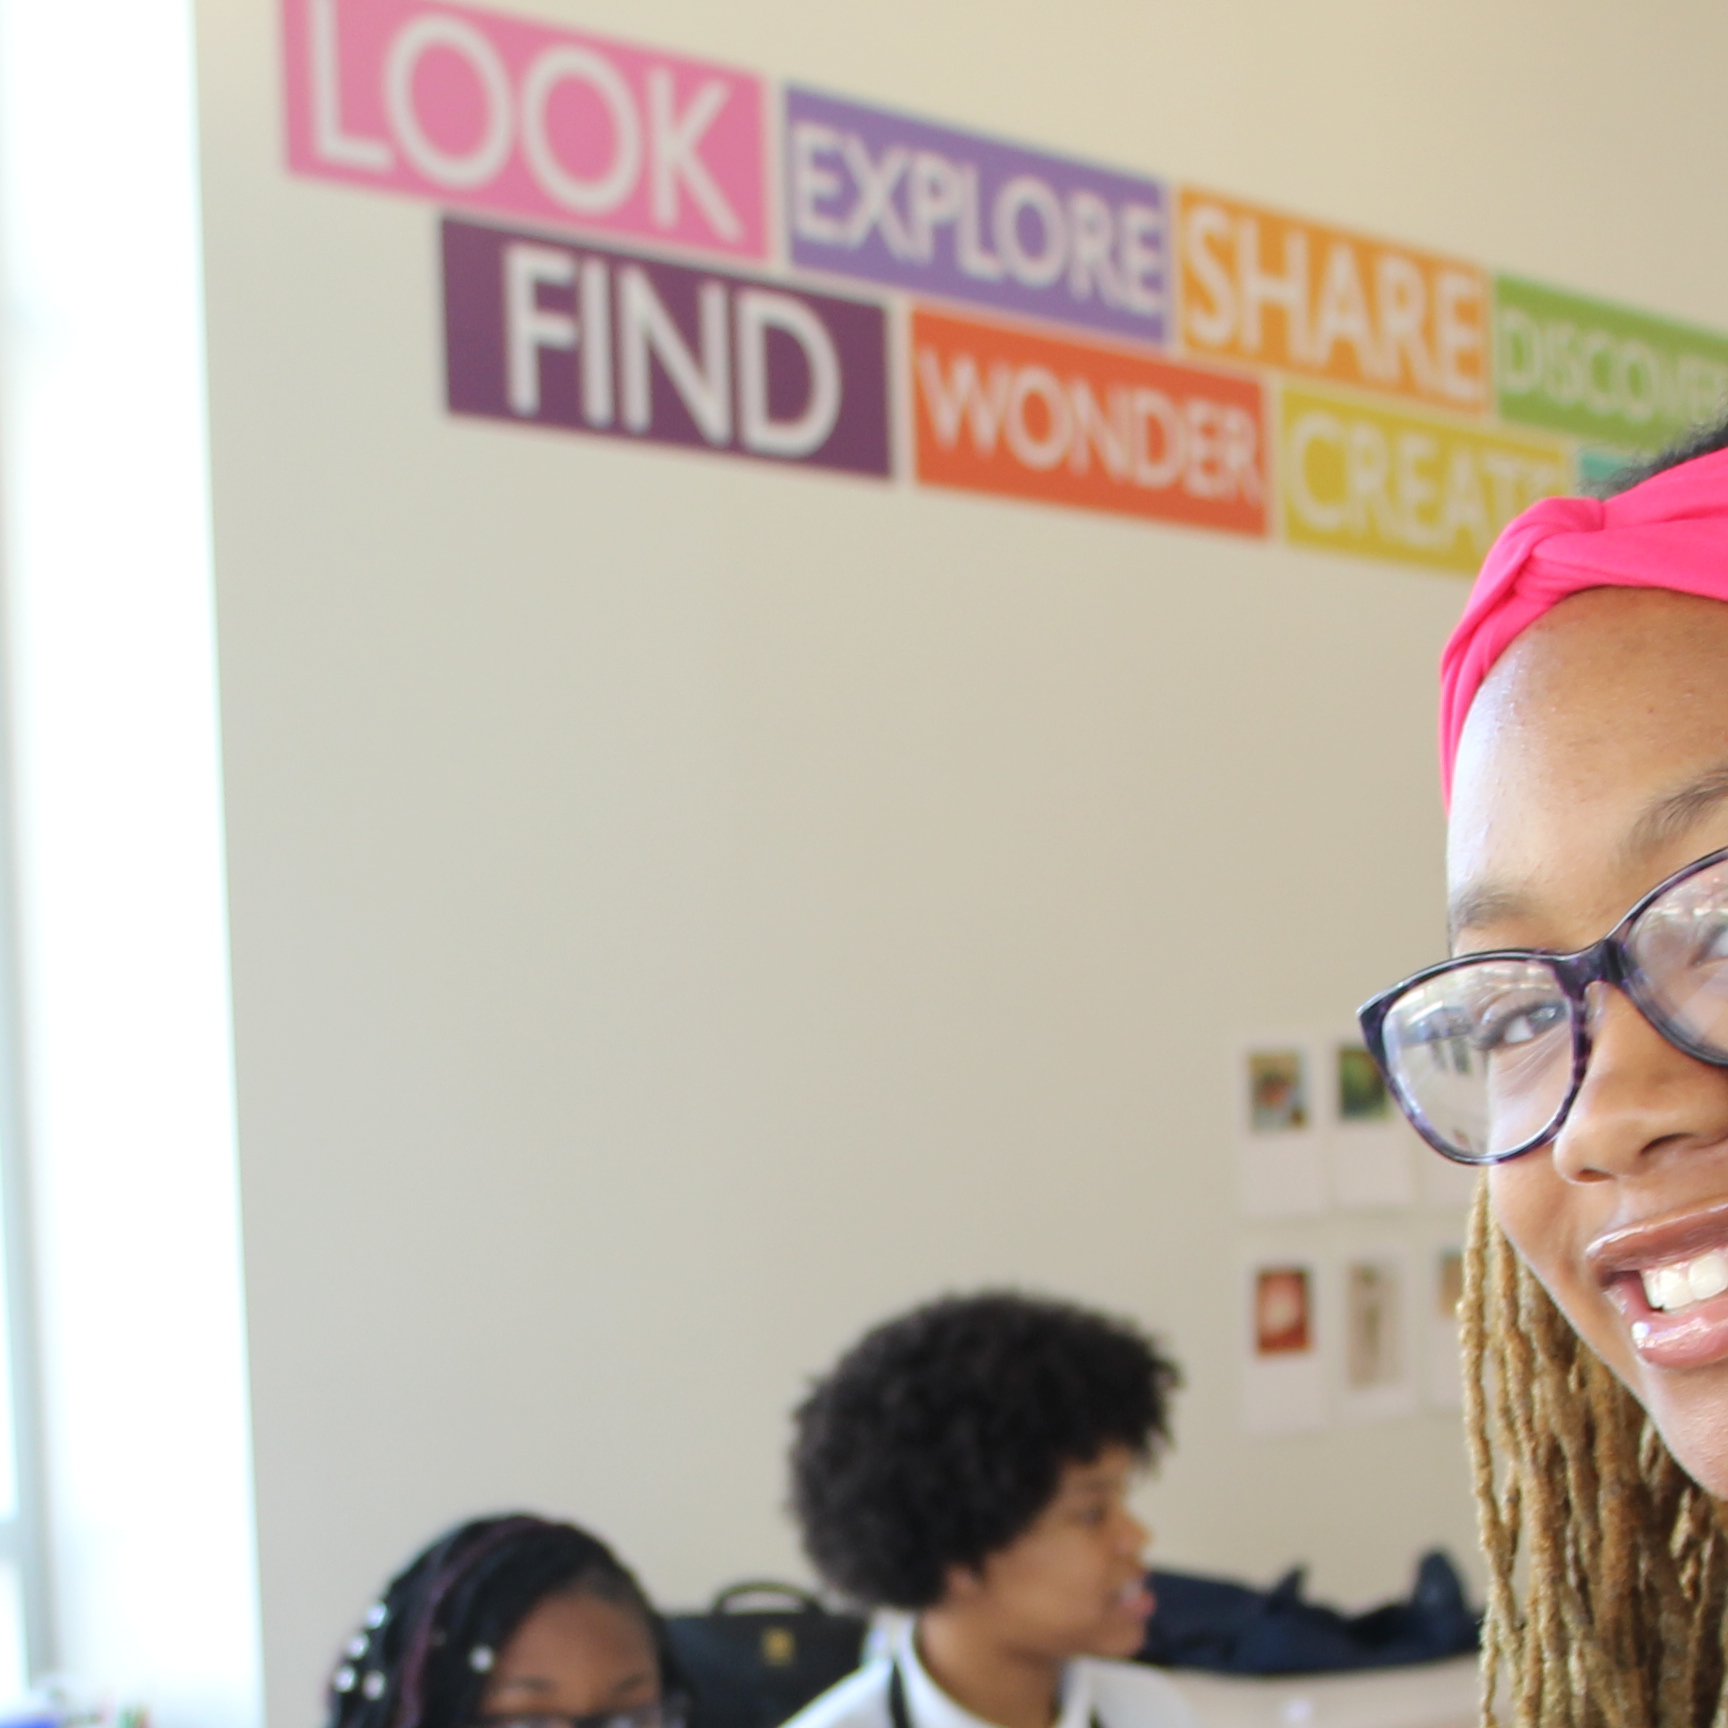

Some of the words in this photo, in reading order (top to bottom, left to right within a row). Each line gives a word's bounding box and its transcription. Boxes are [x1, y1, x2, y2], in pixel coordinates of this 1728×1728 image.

[308, 0, 745, 244] LOOK
[789, 119, 1164, 317] EXPLORE
[1182, 204, 1488, 401] SHARE
[505, 241, 842, 459] FIND
[916, 344, 1266, 508] WONDER
